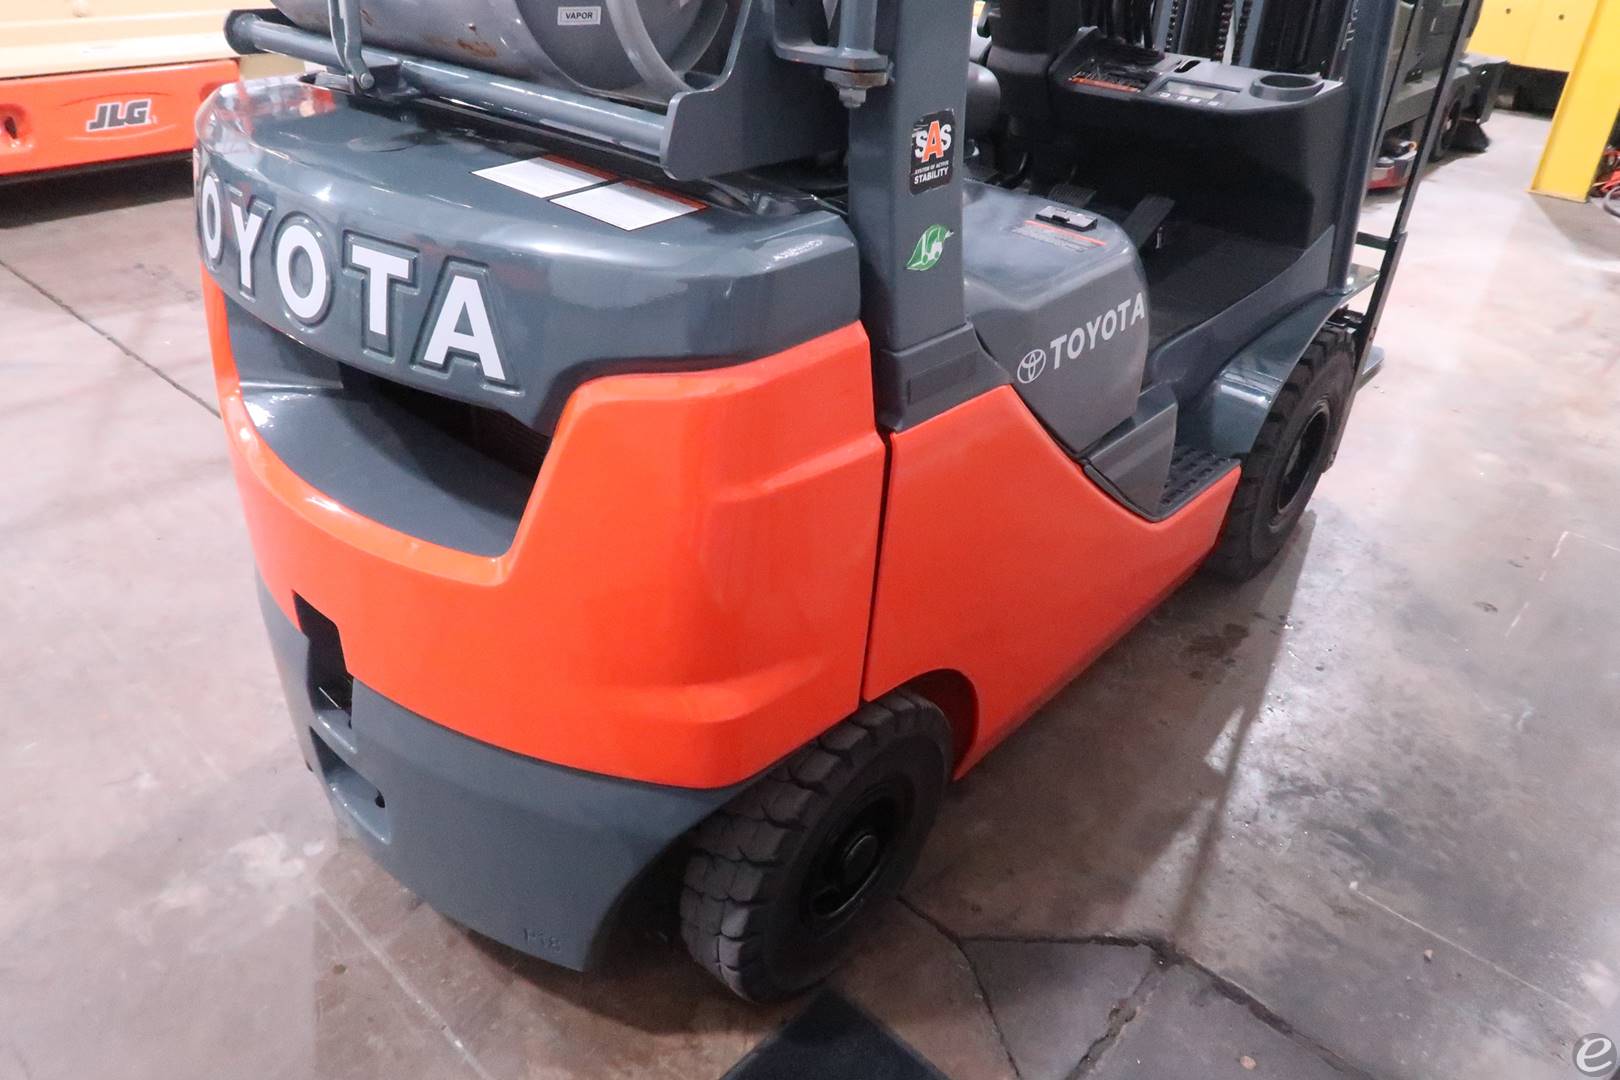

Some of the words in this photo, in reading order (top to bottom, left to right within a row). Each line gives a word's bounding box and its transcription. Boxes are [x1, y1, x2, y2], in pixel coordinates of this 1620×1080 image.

[565, 11, 593, 20] VAPOR
[86, 98, 152, 133] JLG
[912, 120, 952, 163] SAS
[913, 166, 949, 185] STABILITY
[201, 174, 507, 382] OYOTA
[1049, 291, 1145, 370] TOYOTA
